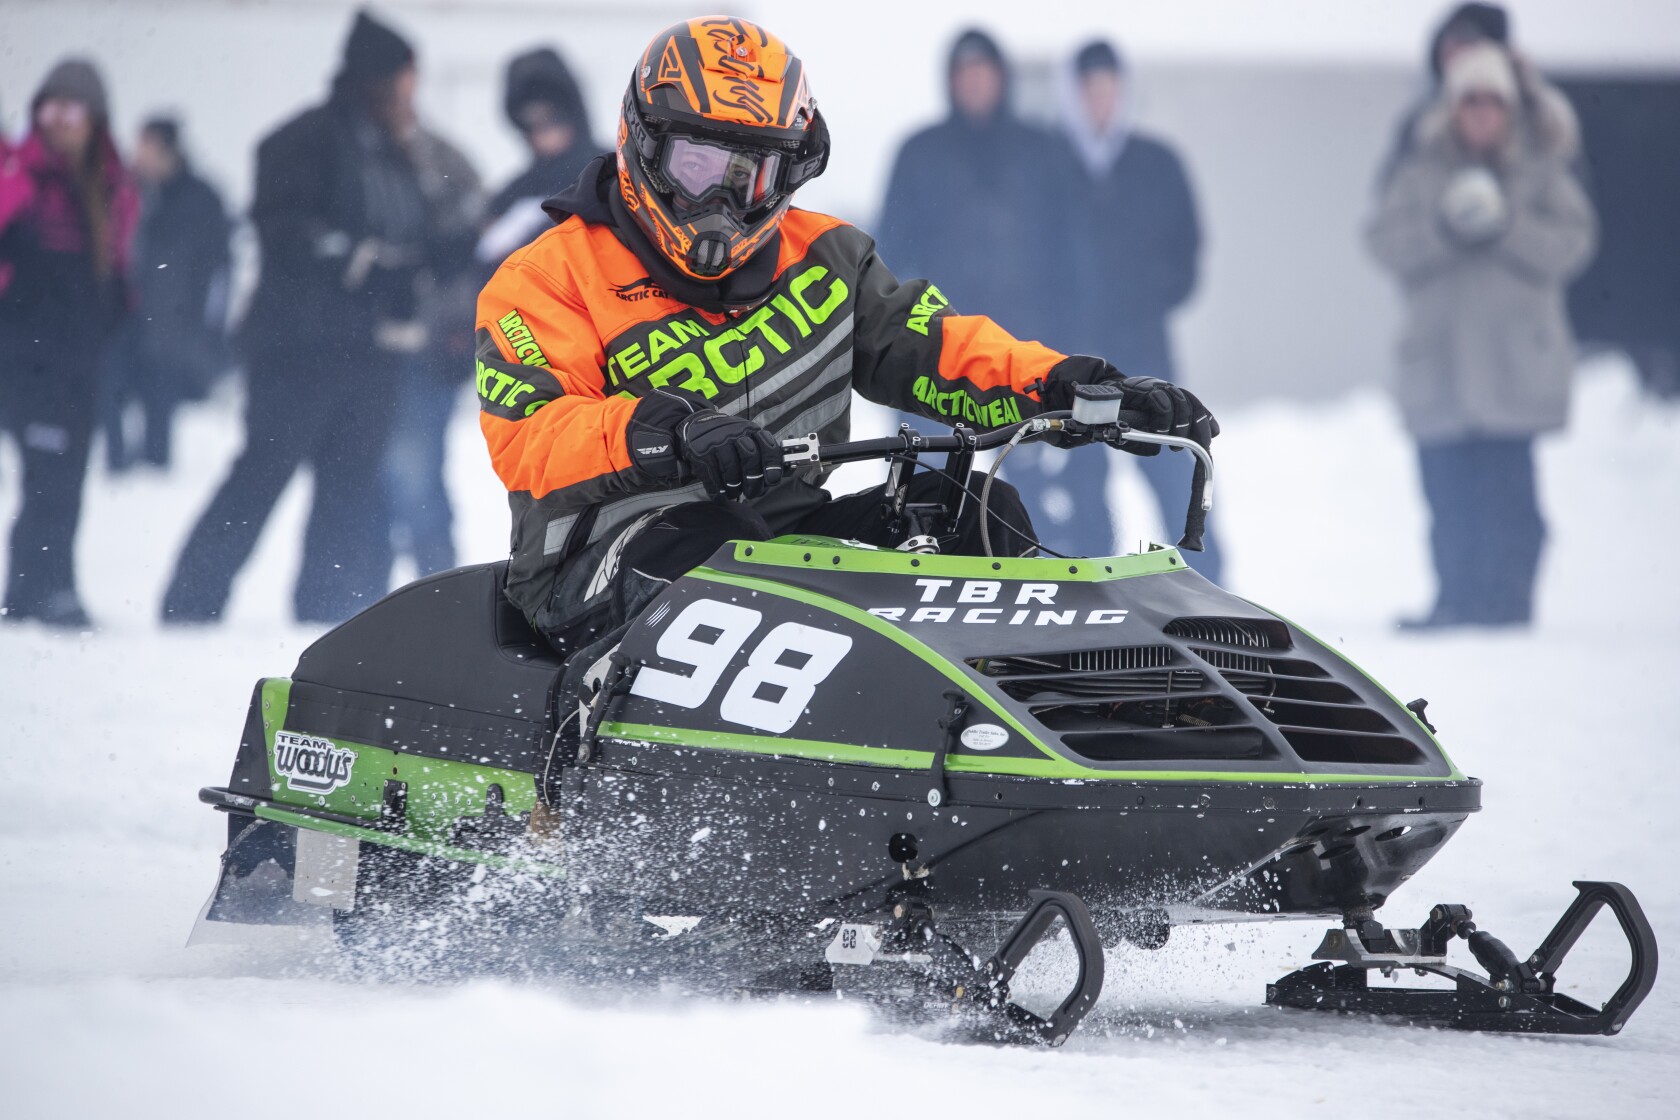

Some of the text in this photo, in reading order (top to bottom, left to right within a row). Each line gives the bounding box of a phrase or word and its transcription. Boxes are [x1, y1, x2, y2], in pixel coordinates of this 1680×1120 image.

[616, 290, 650, 302] ARCTIC
[618, 265, 849, 400] RCTIC
[608, 319, 711, 387] TEAM
[476, 358, 536, 408] RCTIC
[914, 578, 1059, 605] TBR
[867, 607, 1129, 626] RACING
[629, 598, 853, 734] 98
[278, 735, 327, 750] TEAM
[842, 928, 857, 949] 98
